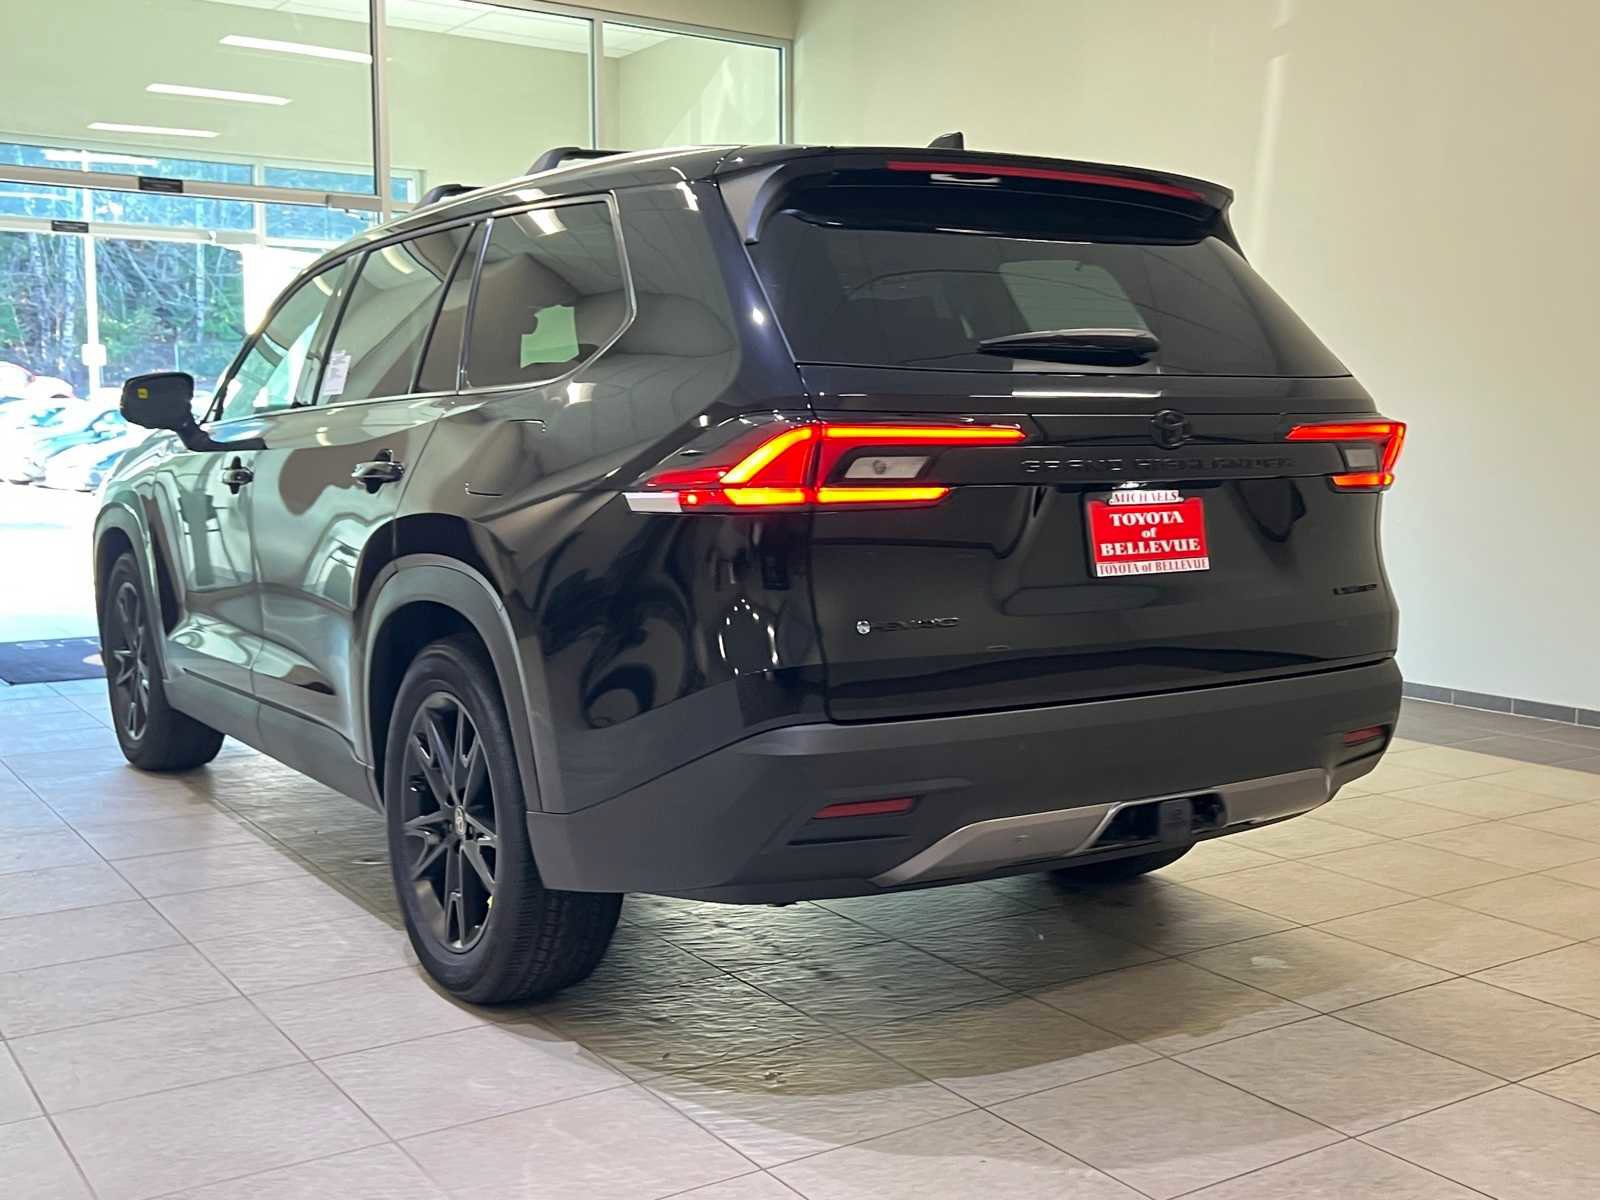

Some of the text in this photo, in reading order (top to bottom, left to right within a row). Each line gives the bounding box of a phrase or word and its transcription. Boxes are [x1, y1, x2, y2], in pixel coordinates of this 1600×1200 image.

[1021, 459, 1122, 474] GRAND
[1114, 491, 1178, 502] MICHAELS
[1109, 511, 1184, 527] TOYOTA
[1141, 527, 1157, 538] of
[1100, 538, 1200, 556] BELLEVUE
[1099, 564, 1140, 575] TOYOTA
[1155, 559, 1206, 571] BELLEVUE
